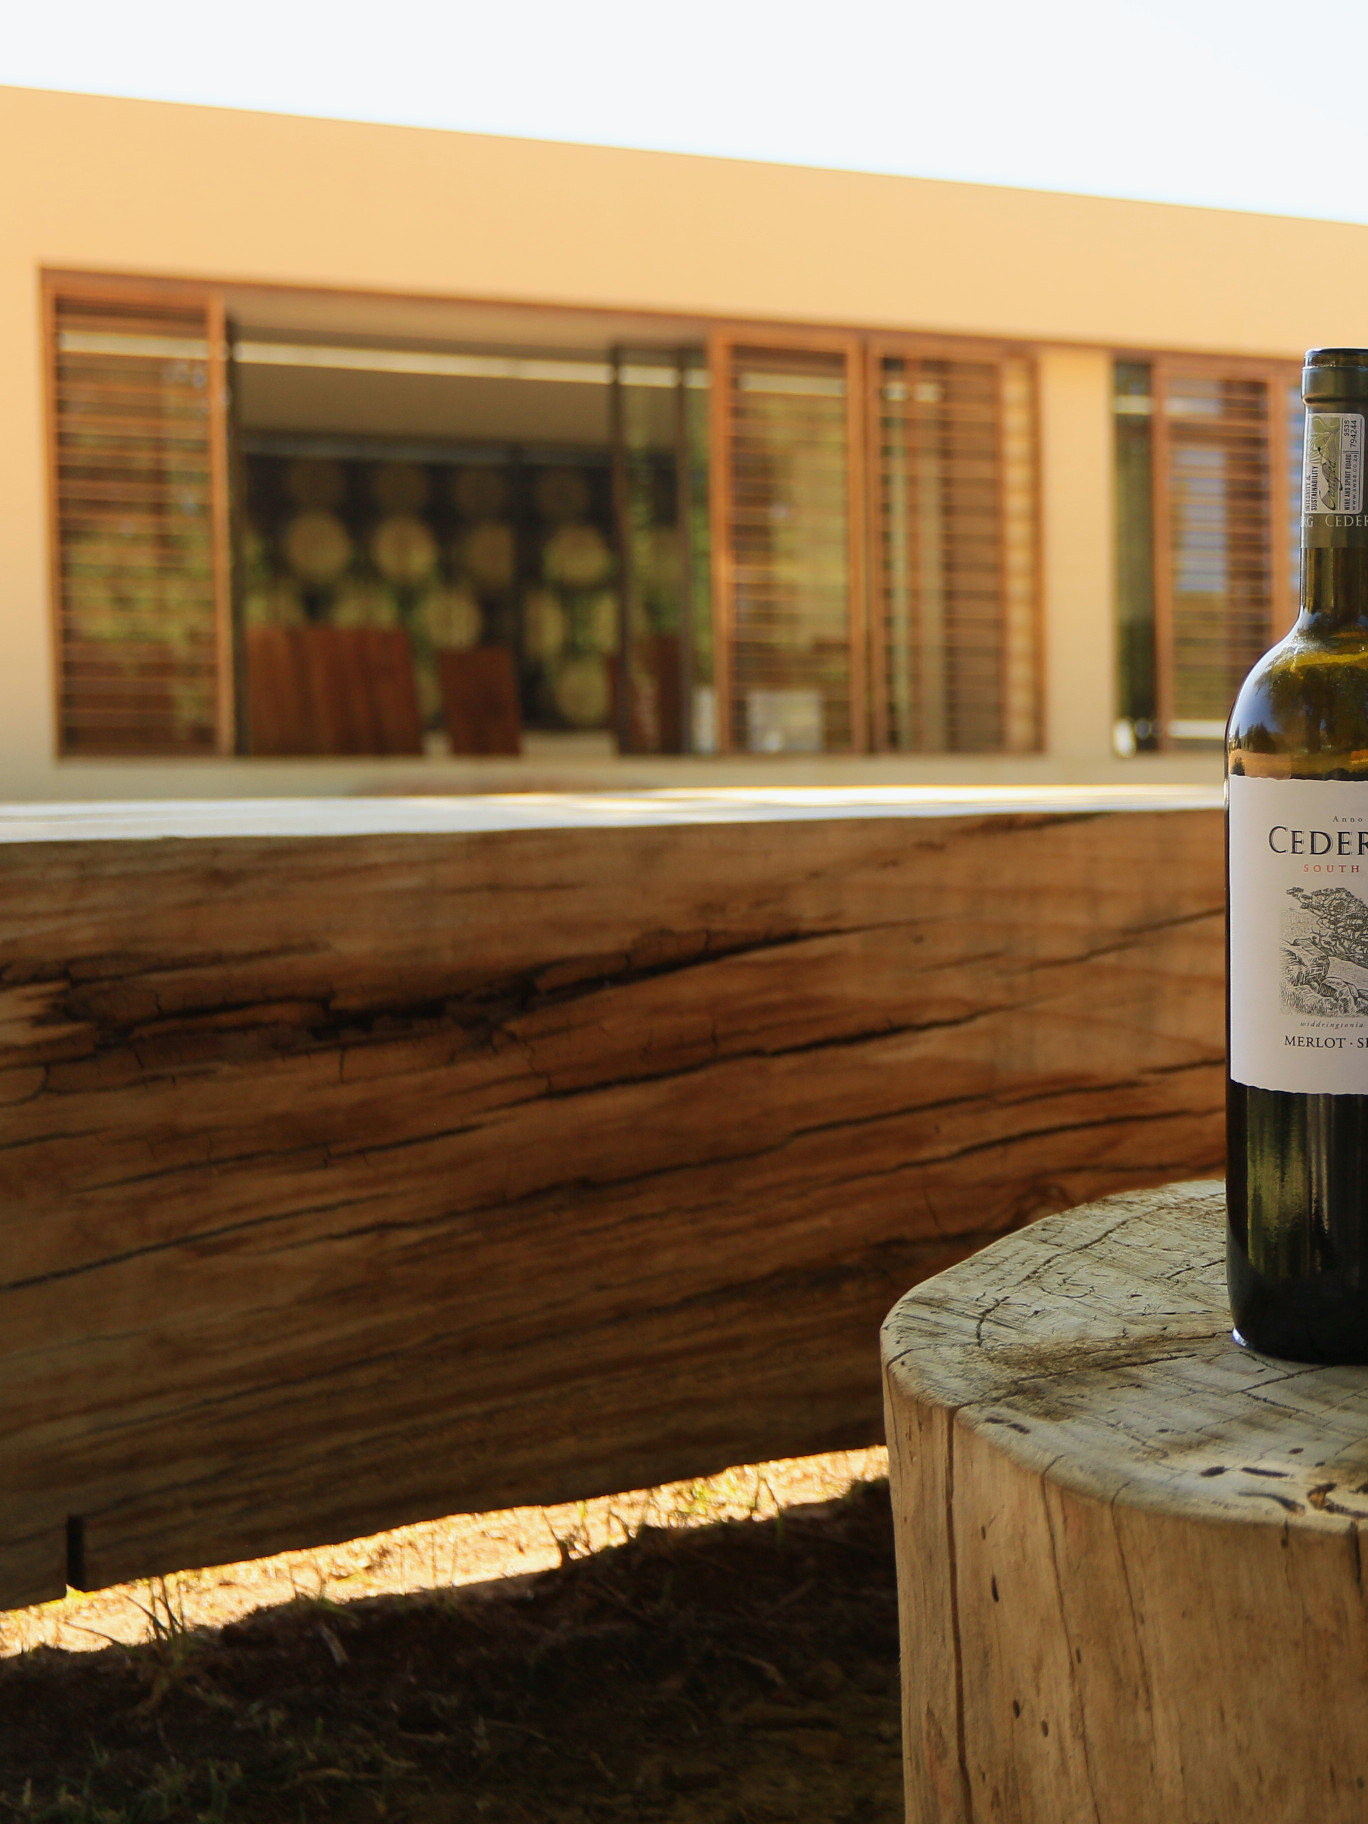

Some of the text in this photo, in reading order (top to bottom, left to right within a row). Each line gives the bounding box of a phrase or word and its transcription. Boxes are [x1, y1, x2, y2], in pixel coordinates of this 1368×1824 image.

[1332, 815, 1363, 823] Anno
[1303, 864, 1360, 873] SOUTH
[1300, 1020, 1364, 1030] widdringtonia
[1284, 1035, 1347, 1049] MERLOT
